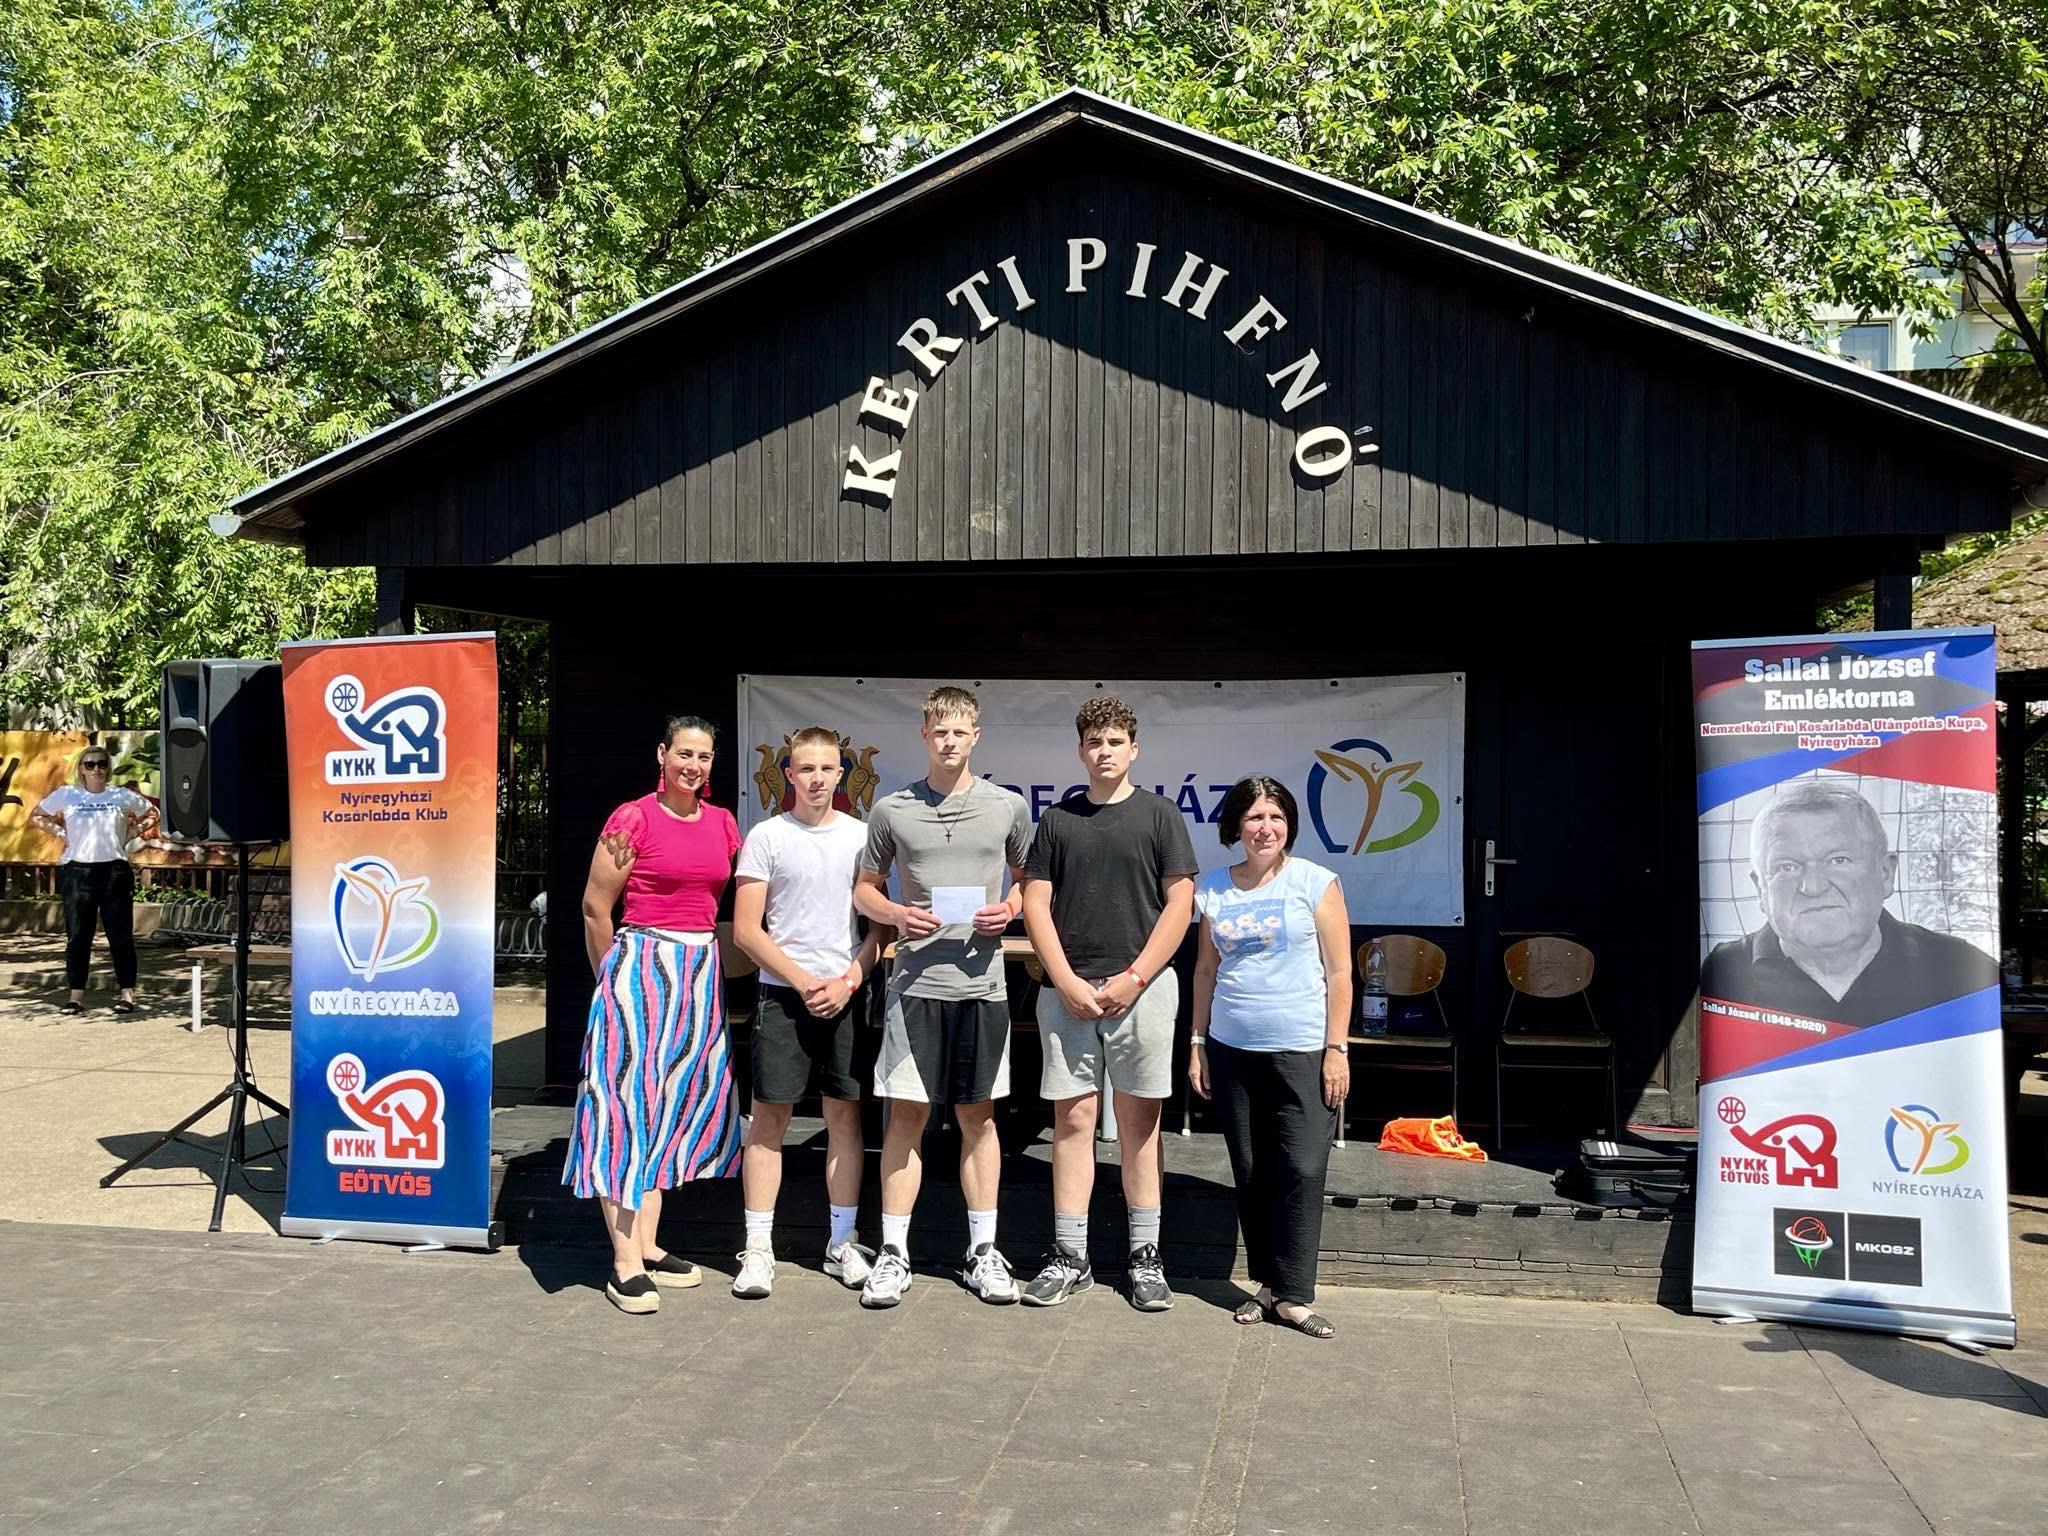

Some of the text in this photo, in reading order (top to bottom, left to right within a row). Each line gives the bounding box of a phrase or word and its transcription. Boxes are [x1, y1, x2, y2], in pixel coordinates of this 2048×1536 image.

[842, 255, 1036, 500] KERTI
[1744, 650, 1937, 683] Sallai József
[1763, 689, 1916, 712] Emléktorna
[1701, 721, 1772, 735] Nemzetközi
[1798, 720, 1870, 733] Kosárlabda
[1873, 717, 1943, 732] Utánpótlás
[1799, 733, 1880, 749] Nyíregyháza
[332, 757, 376, 777] NYKK
[340, 789, 433, 807] Nyíregyházi
[322, 807, 449, 823] Kosárlabda Klub
[314, 993, 457, 1012] NYÍREGYHÁZA
[333, 1137, 377, 1159] NYKK
[1720, 1156, 1769, 1172] NYKK
[339, 1168, 432, 1197] EÖTVÖS
[1872, 1179, 1984, 1201] NYÍREGYHÁZA
[1854, 1241, 1916, 1257] MKOSZ
